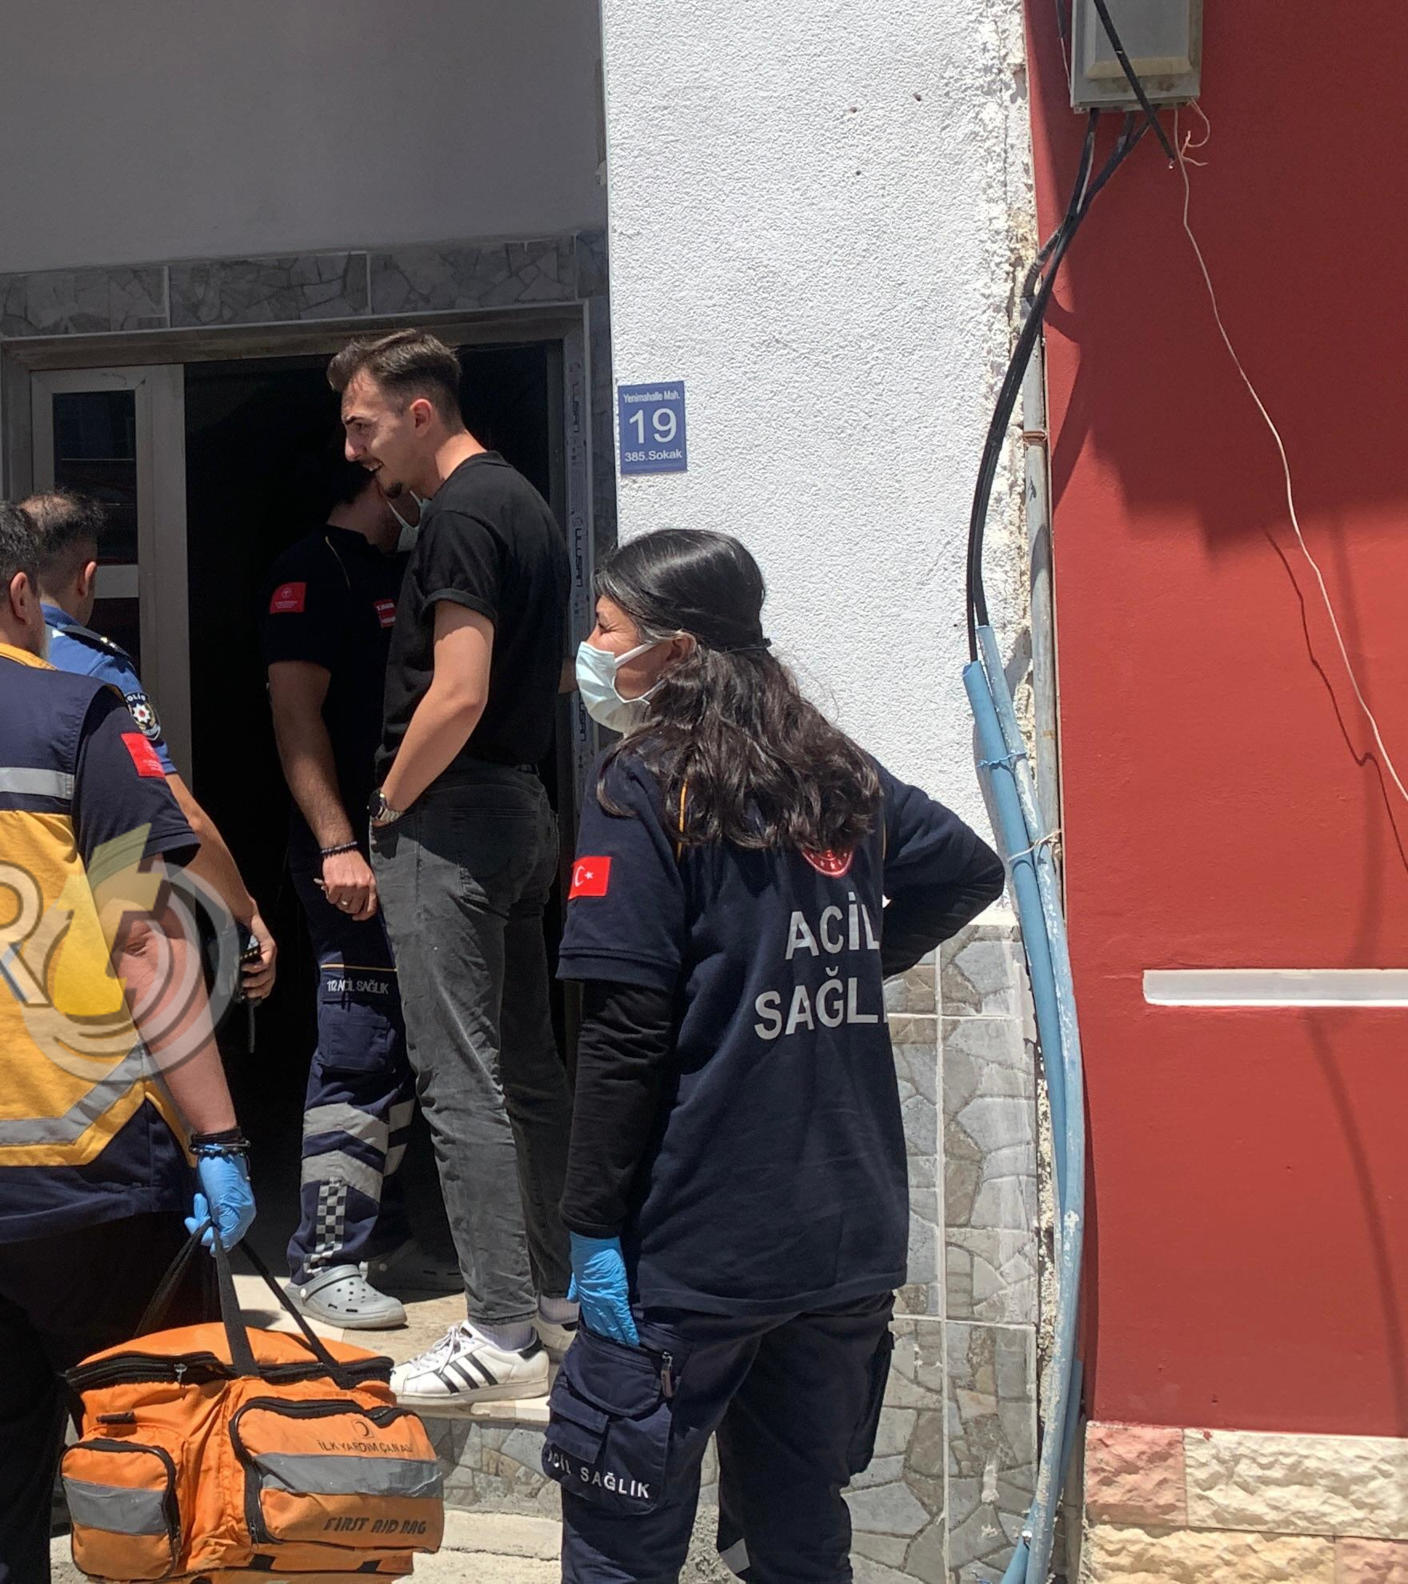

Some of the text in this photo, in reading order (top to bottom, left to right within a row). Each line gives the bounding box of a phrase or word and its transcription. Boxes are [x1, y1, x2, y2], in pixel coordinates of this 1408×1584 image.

[623, 390, 680, 403] Yenimahalle Mah.
[629, 407, 677, 444] 19
[625, 449, 683, 462] 385.Sokak
[784, 891, 881, 961] ACİL
[356, 979, 389, 995] SAĞLIK
[753, 965, 888, 1041] SAĞL
[579, 1466, 651, 1499] SAĞLIK
[323, 1516, 370, 1532] FIRST
